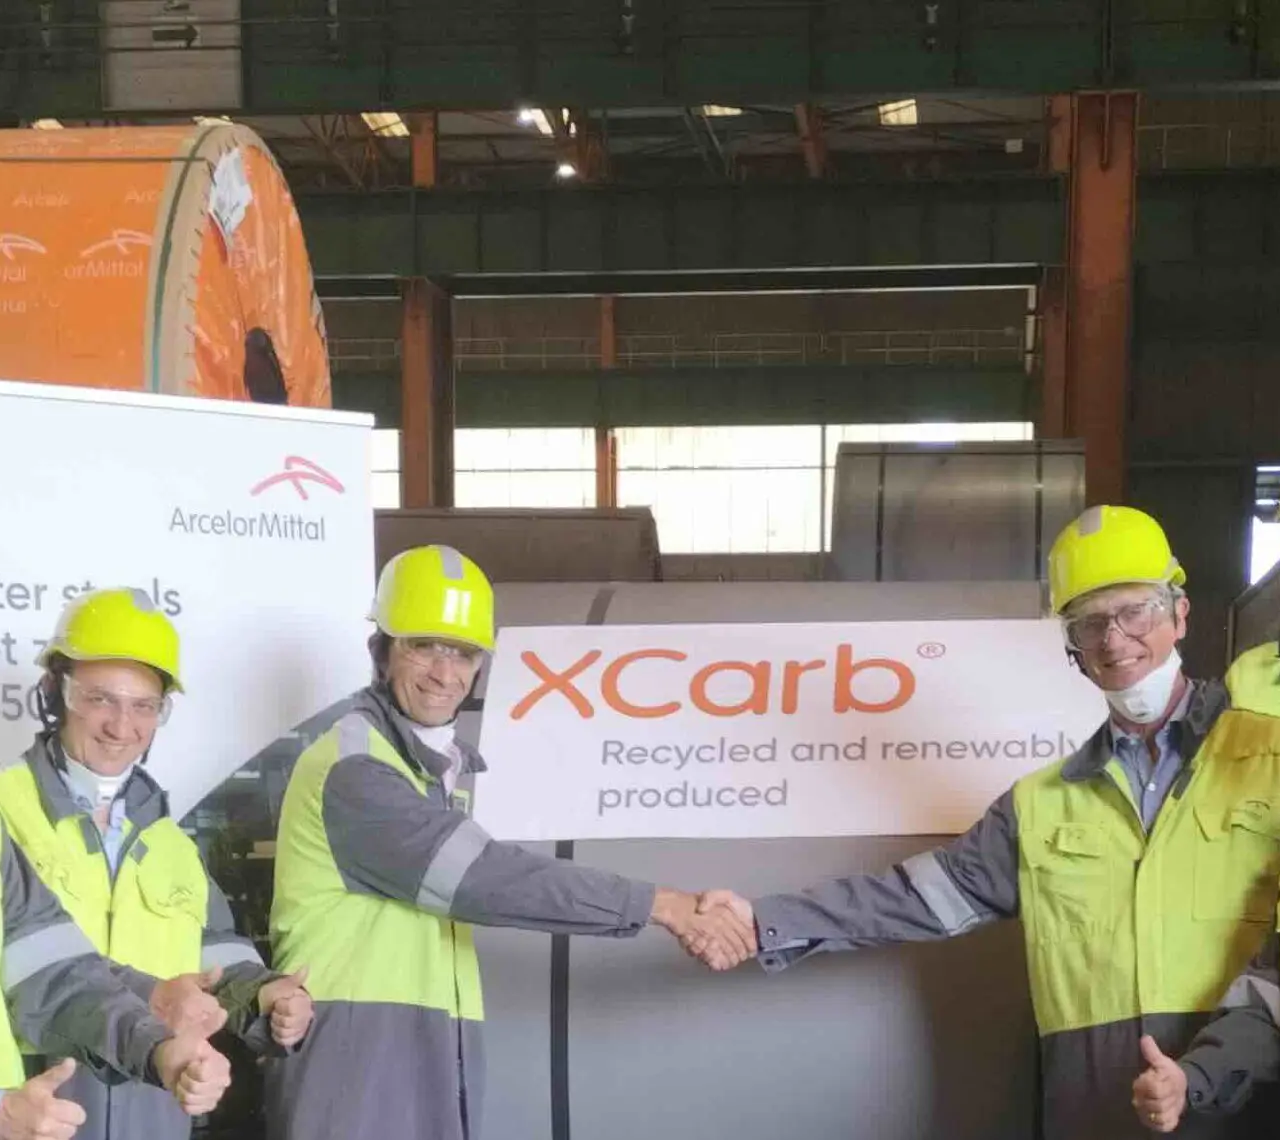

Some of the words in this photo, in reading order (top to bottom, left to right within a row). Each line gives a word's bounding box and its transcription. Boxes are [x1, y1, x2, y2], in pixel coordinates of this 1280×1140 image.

[169, 506, 326, 542] ArcelorMittal
[62, 576, 183, 617] stls
[601, 736, 777, 770] Recycled
[790, 736, 868, 762] and
[597, 778, 788, 816] produced
